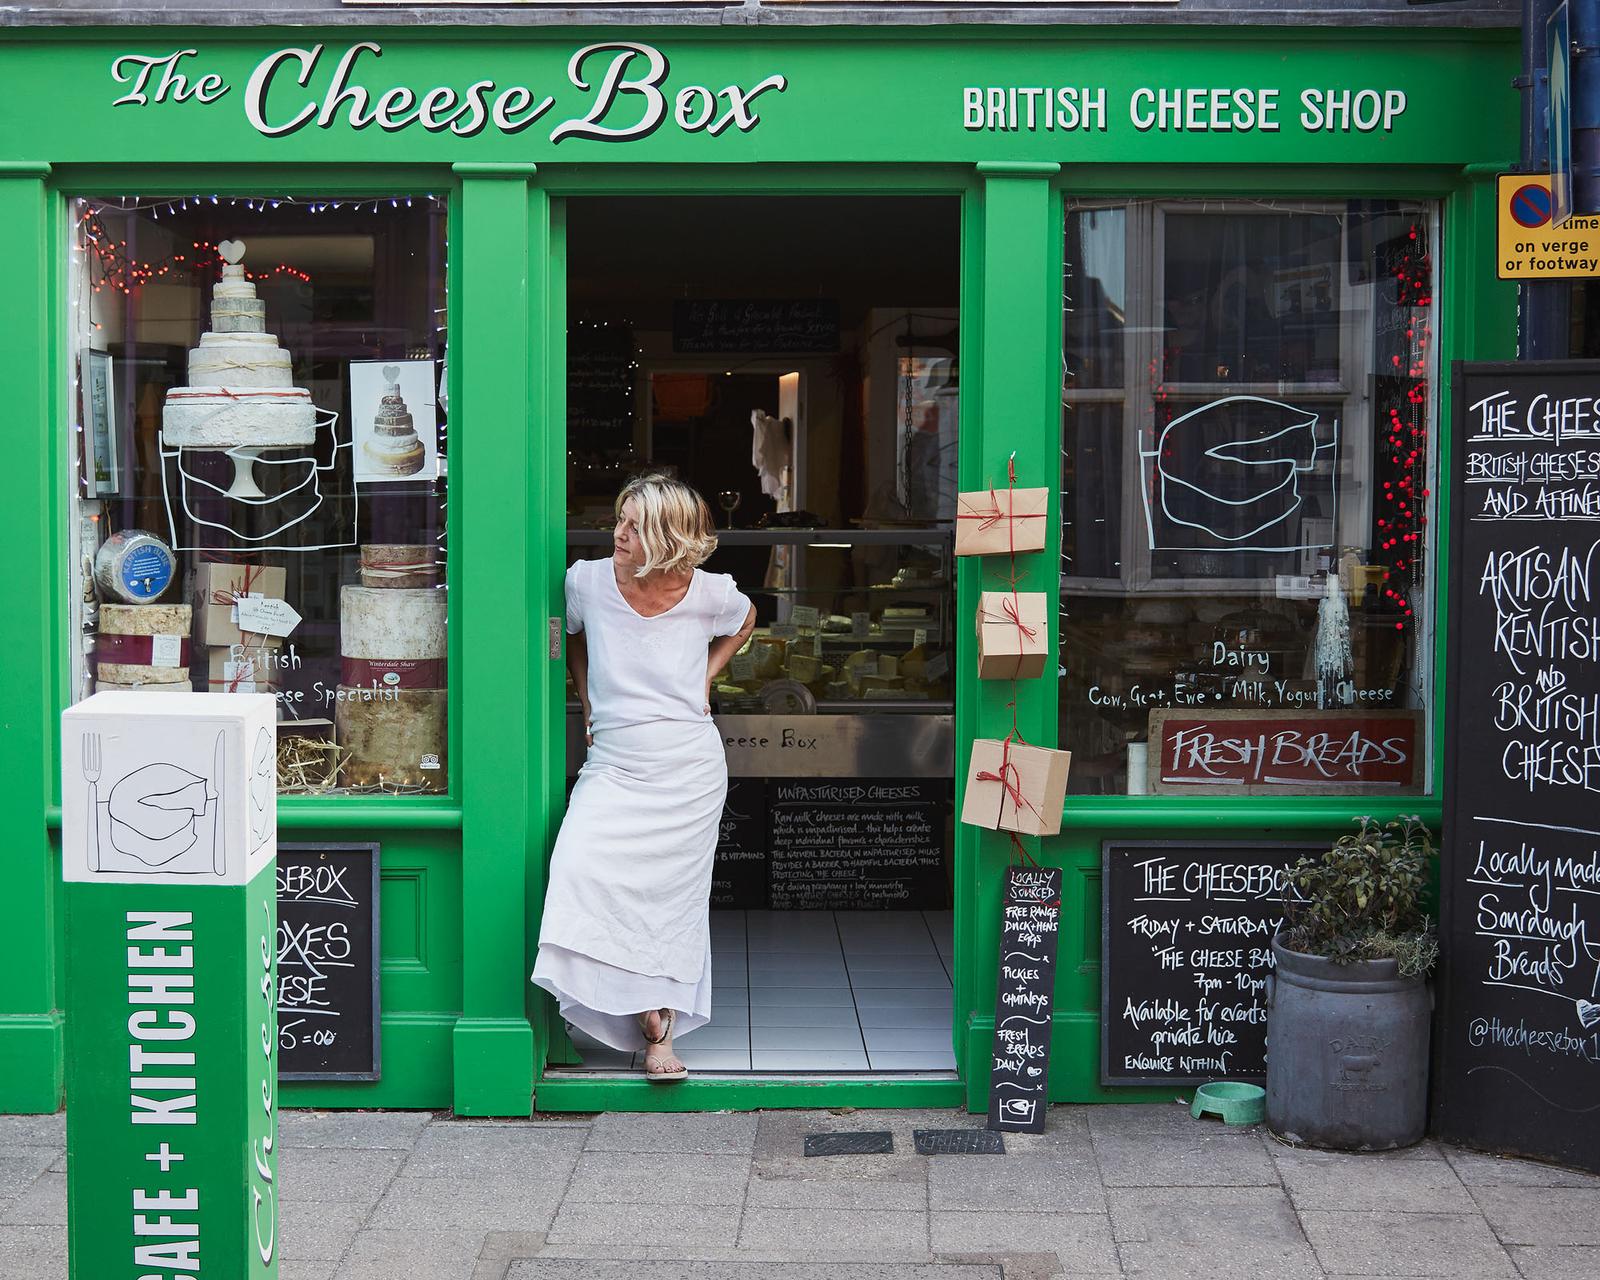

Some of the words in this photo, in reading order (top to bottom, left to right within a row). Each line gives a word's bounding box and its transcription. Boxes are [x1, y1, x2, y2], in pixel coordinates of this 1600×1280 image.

[111, 49, 231, 107] The
[244, 41, 555, 139] Cheese
[550, 41, 787, 145] Box
[963, 87, 1107, 131] BRITISH
[1129, 88, 1280, 132] CHEESE
[1300, 89, 1408, 132] SHOP
[1562, 219, 1599, 230] time
[1515, 242, 1535, 253] on
[1542, 241, 1589, 254] verge
[1505, 260, 1523, 271] or
[1529, 256, 1598, 271] footway
[1469, 390, 1520, 437] THE
[1466, 451, 1528, 485] BRITISH
[1483, 486, 1528, 519] AND
[1535, 482, 1600, 520] AFFINE
[1479, 539, 1600, 619] ARTISAN
[230, 644, 302, 671] British
[1213, 642, 1270, 675] Dairy
[313, 679, 399, 709] Specialist
[1535, 664, 1566, 694] AND
[1089, 686, 1127, 710] Cow,
[1174, 683, 1206, 704] Ewe
[1231, 680, 1272, 707] Milk,
[1274, 680, 1332, 708] Yogur,
[1336, 680, 1393, 704] Cheese
[1492, 681, 1600, 750] BRITISH
[781, 728, 817, 750] Box
[1167, 725, 1265, 779] FRESH
[1270, 730, 1407, 777] BREADS
[777, 785, 866, 804] UNPASTURISED
[867, 785, 920, 800] CHEESES
[1010, 871, 1055, 888] LOCALLY
[1133, 857, 1179, 894] THE
[1474, 841, 1550, 913] Locally
[1010, 886, 1055, 902] SOURCED
[1005, 906, 1028, 920] FREE
[1029, 906, 1058, 922] RANGE
[1018, 933, 1042, 948] EGGS
[1127, 915, 1180, 944] FRIDAY
[1198, 916, 1284, 938] SATURDAY
[1477, 893, 1600, 968] Sourdough
[1190, 949, 1244, 968] CHEESE
[1489, 939, 1563, 985] Breads
[1002, 966, 1040, 984] PICKLES
[1193, 972, 1222, 996] 7pm
[277, 975, 330, 1006] ESE
[1002, 991, 1049, 1014] CHUTNEYS
[126, 911, 198, 1125] KITCHEN
[1122, 997, 1191, 1030] Available
[1195, 997, 1220, 1026] for
[1221, 998, 1267, 1024] events
[997, 1028, 1028, 1046] FRESH
[1006, 1043, 1046, 1060] BREADS
[1150, 1022, 1204, 1056] private
[1207, 1022, 1238, 1045] hire
[994, 1058, 1026, 1075] DAILY
[1124, 1052, 1175, 1072] ENQUIRE
[252, 899, 275, 1268] Cheese
[132, 1188, 201, 1280] AFE
